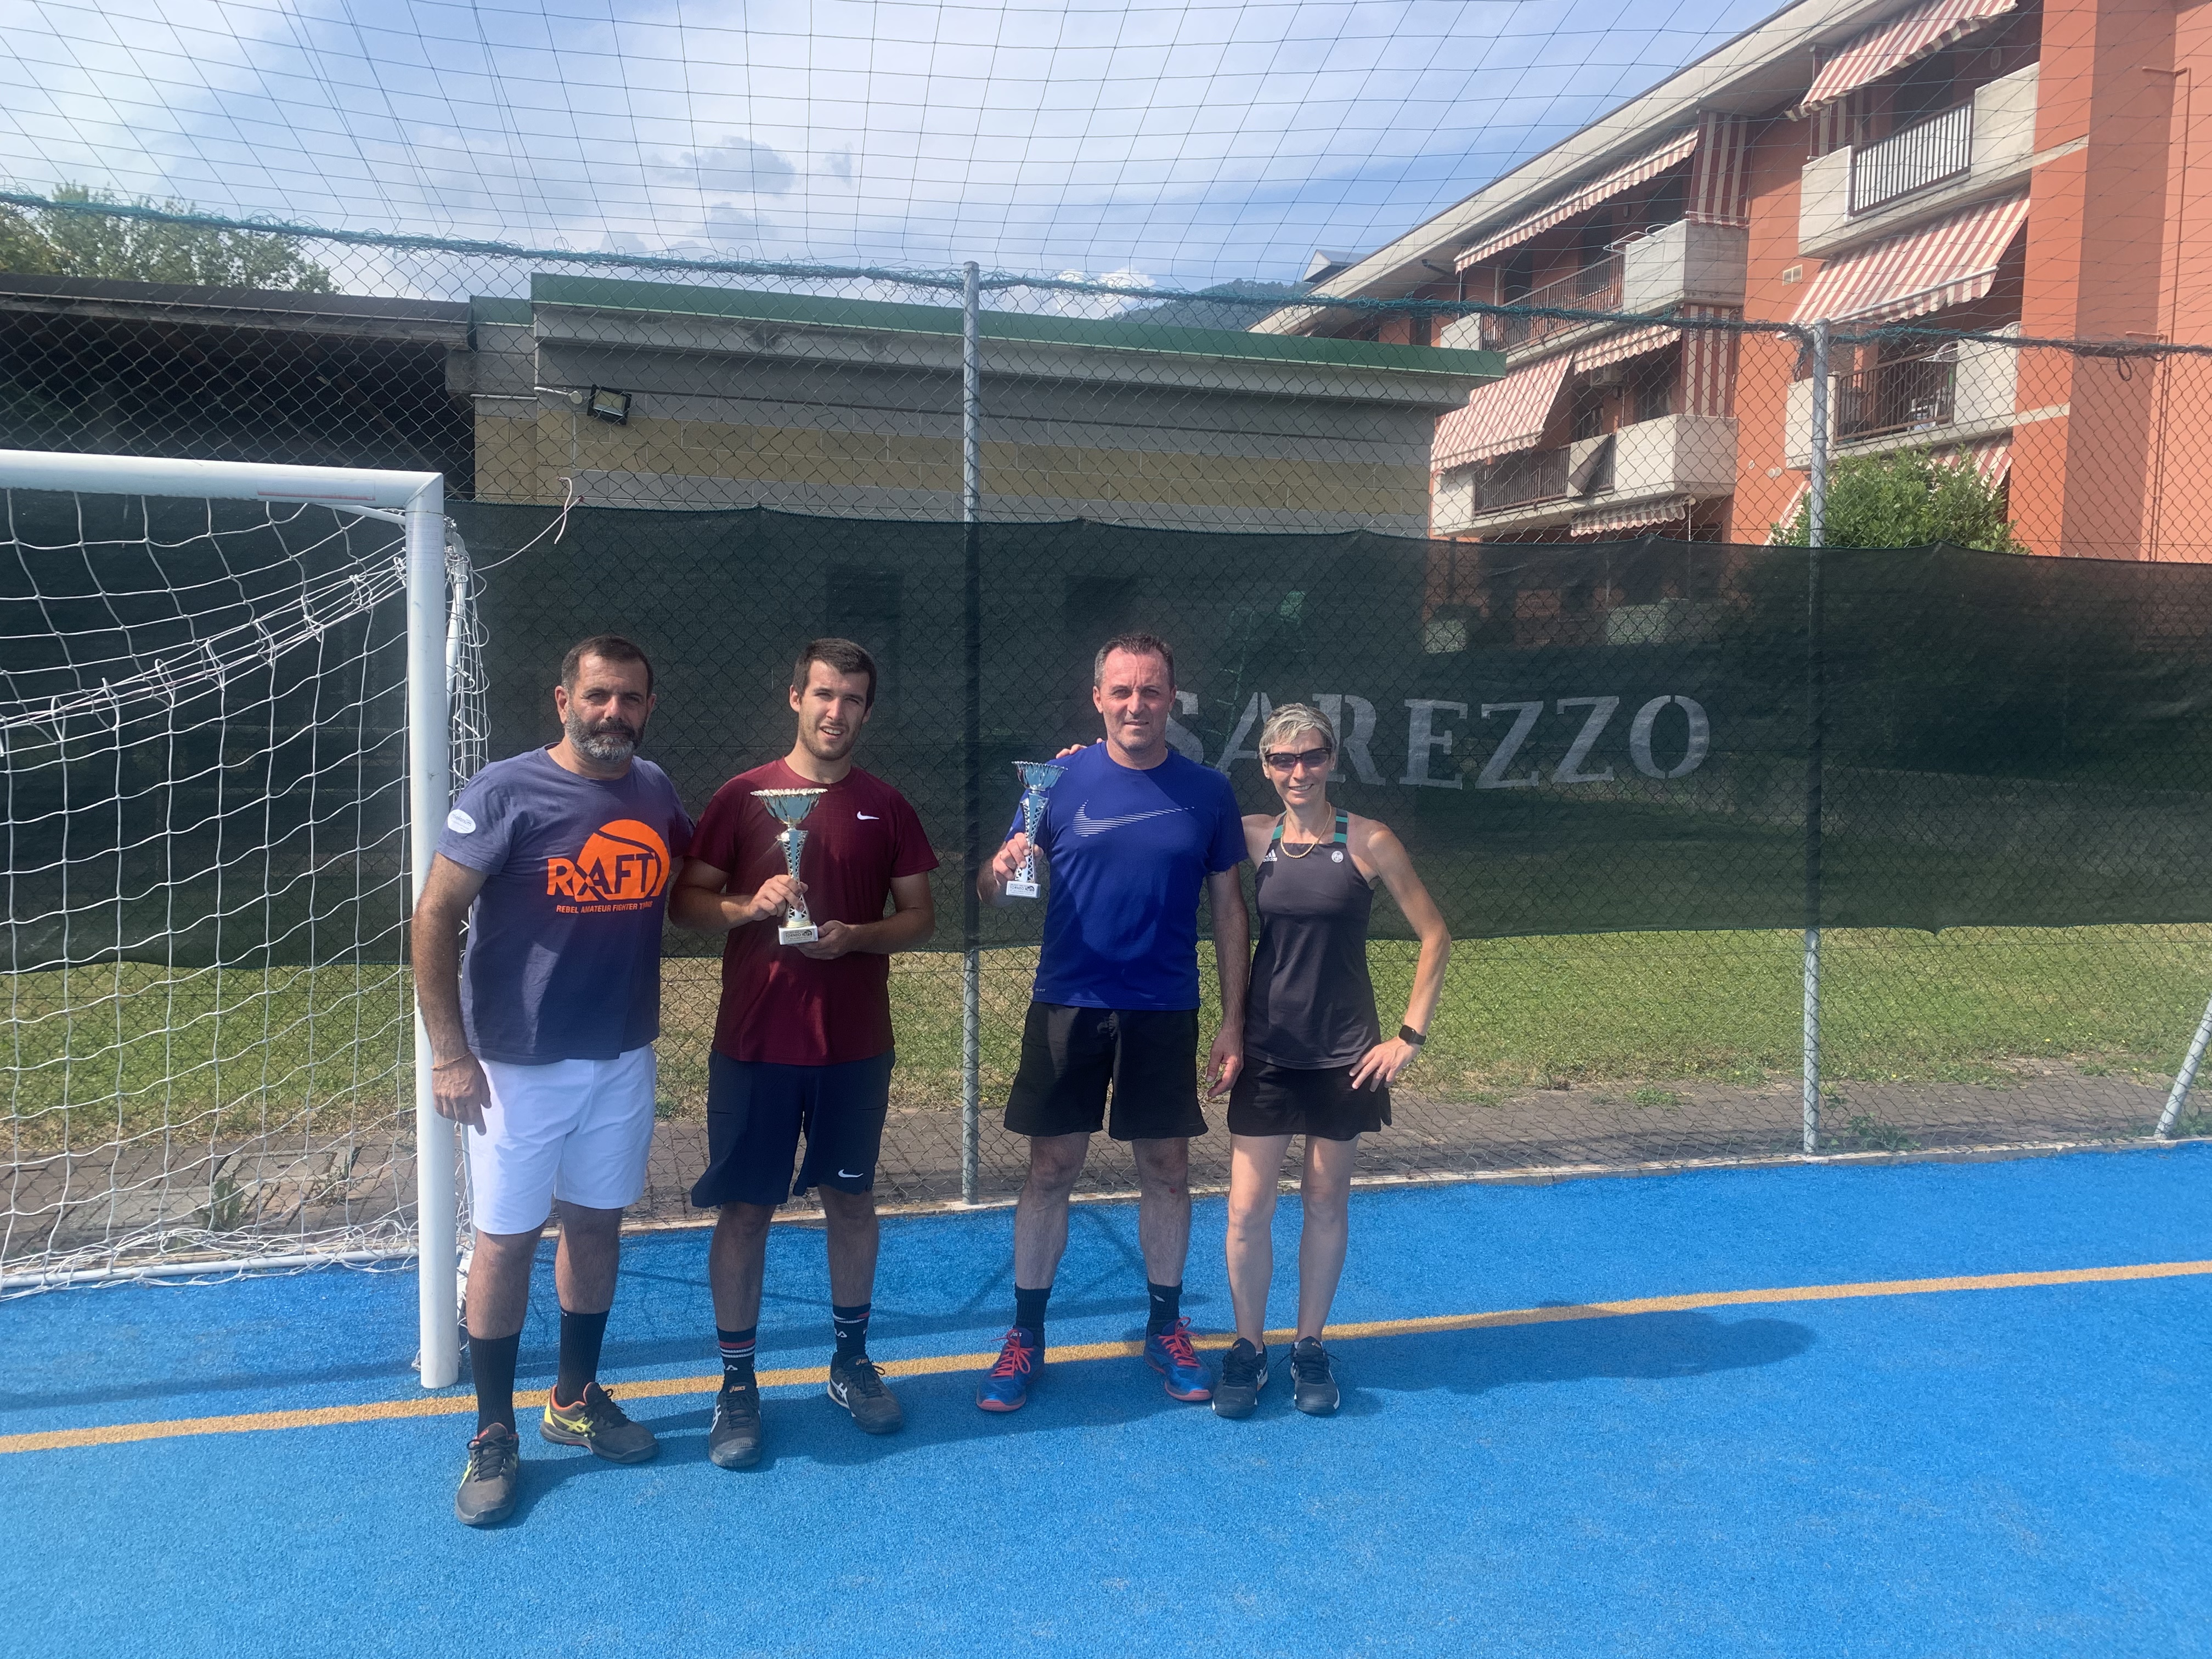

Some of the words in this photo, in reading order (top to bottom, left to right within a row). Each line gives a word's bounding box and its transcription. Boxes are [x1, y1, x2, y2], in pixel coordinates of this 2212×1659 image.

[547, 852, 656, 897] RAFT
[556, 905, 579, 913] REBEL
[580, 904, 611, 913] AMATEUR
[612, 903, 637, 912] FIGHTER
